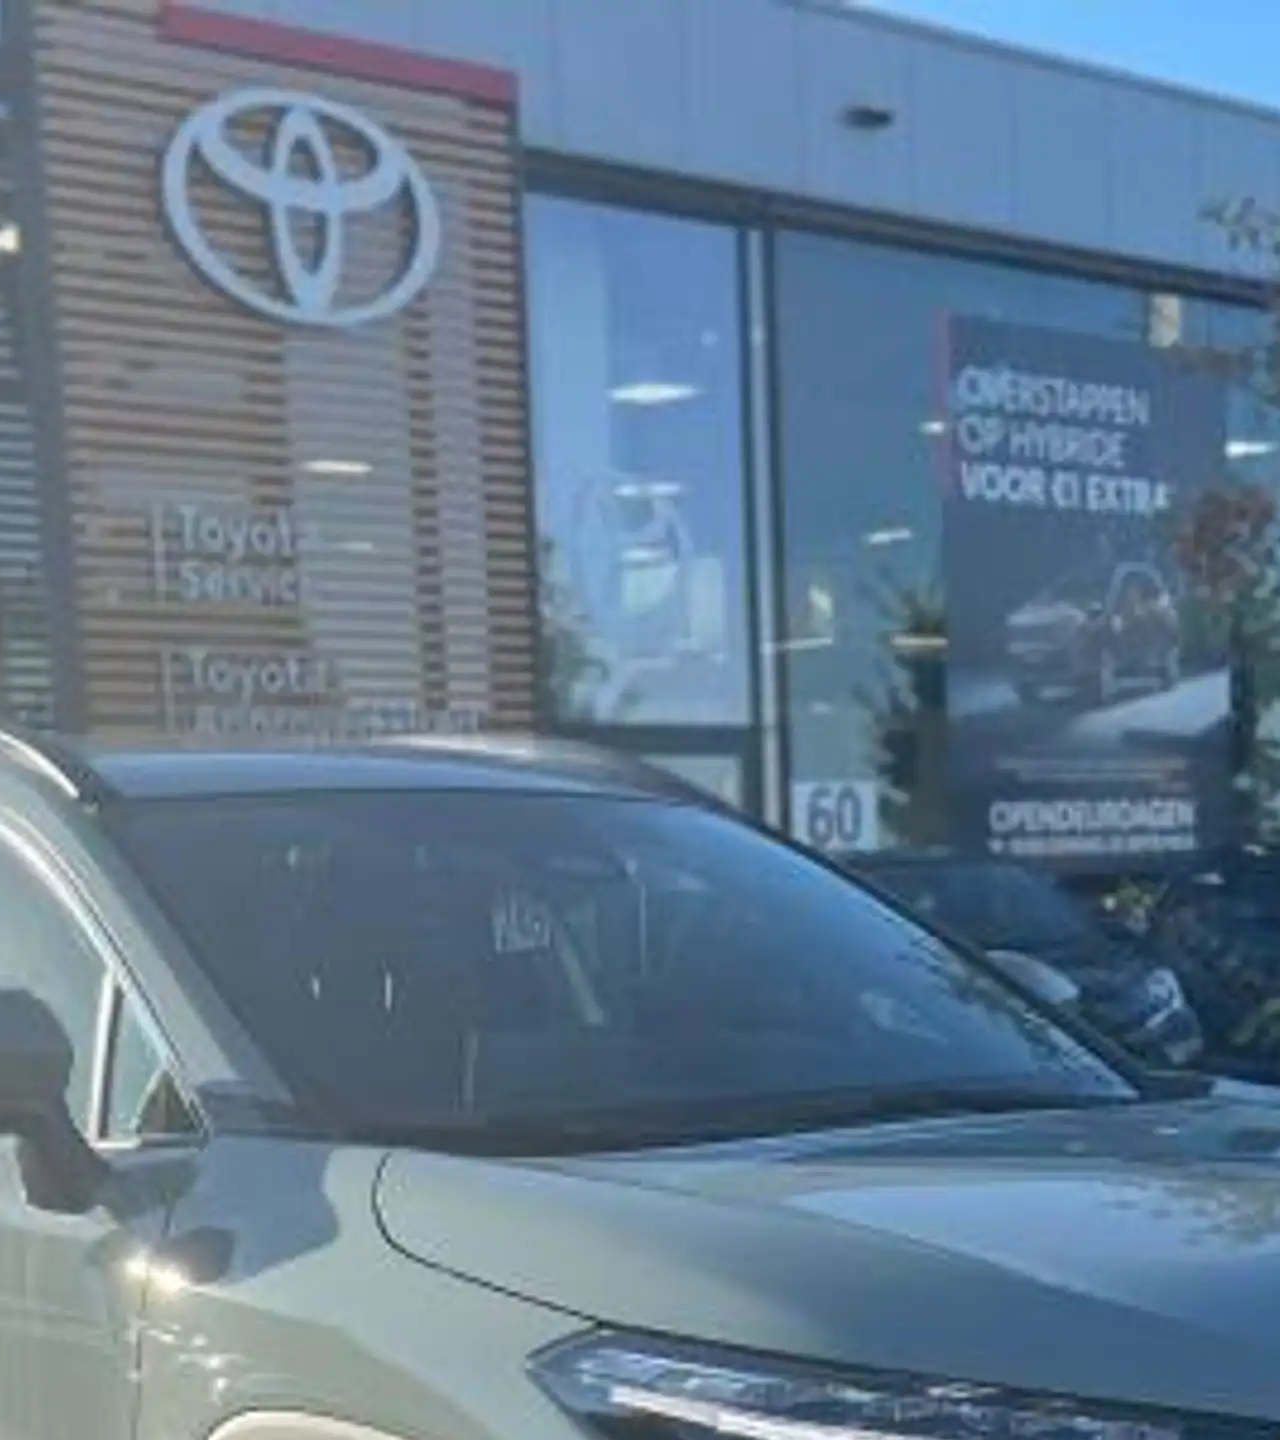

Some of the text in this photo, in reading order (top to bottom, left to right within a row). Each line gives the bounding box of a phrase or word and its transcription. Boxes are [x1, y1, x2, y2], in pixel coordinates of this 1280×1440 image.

[958, 413, 1005, 456] OP
[960, 459, 1047, 506] VOOR
[804, 784, 862, 846] 60
